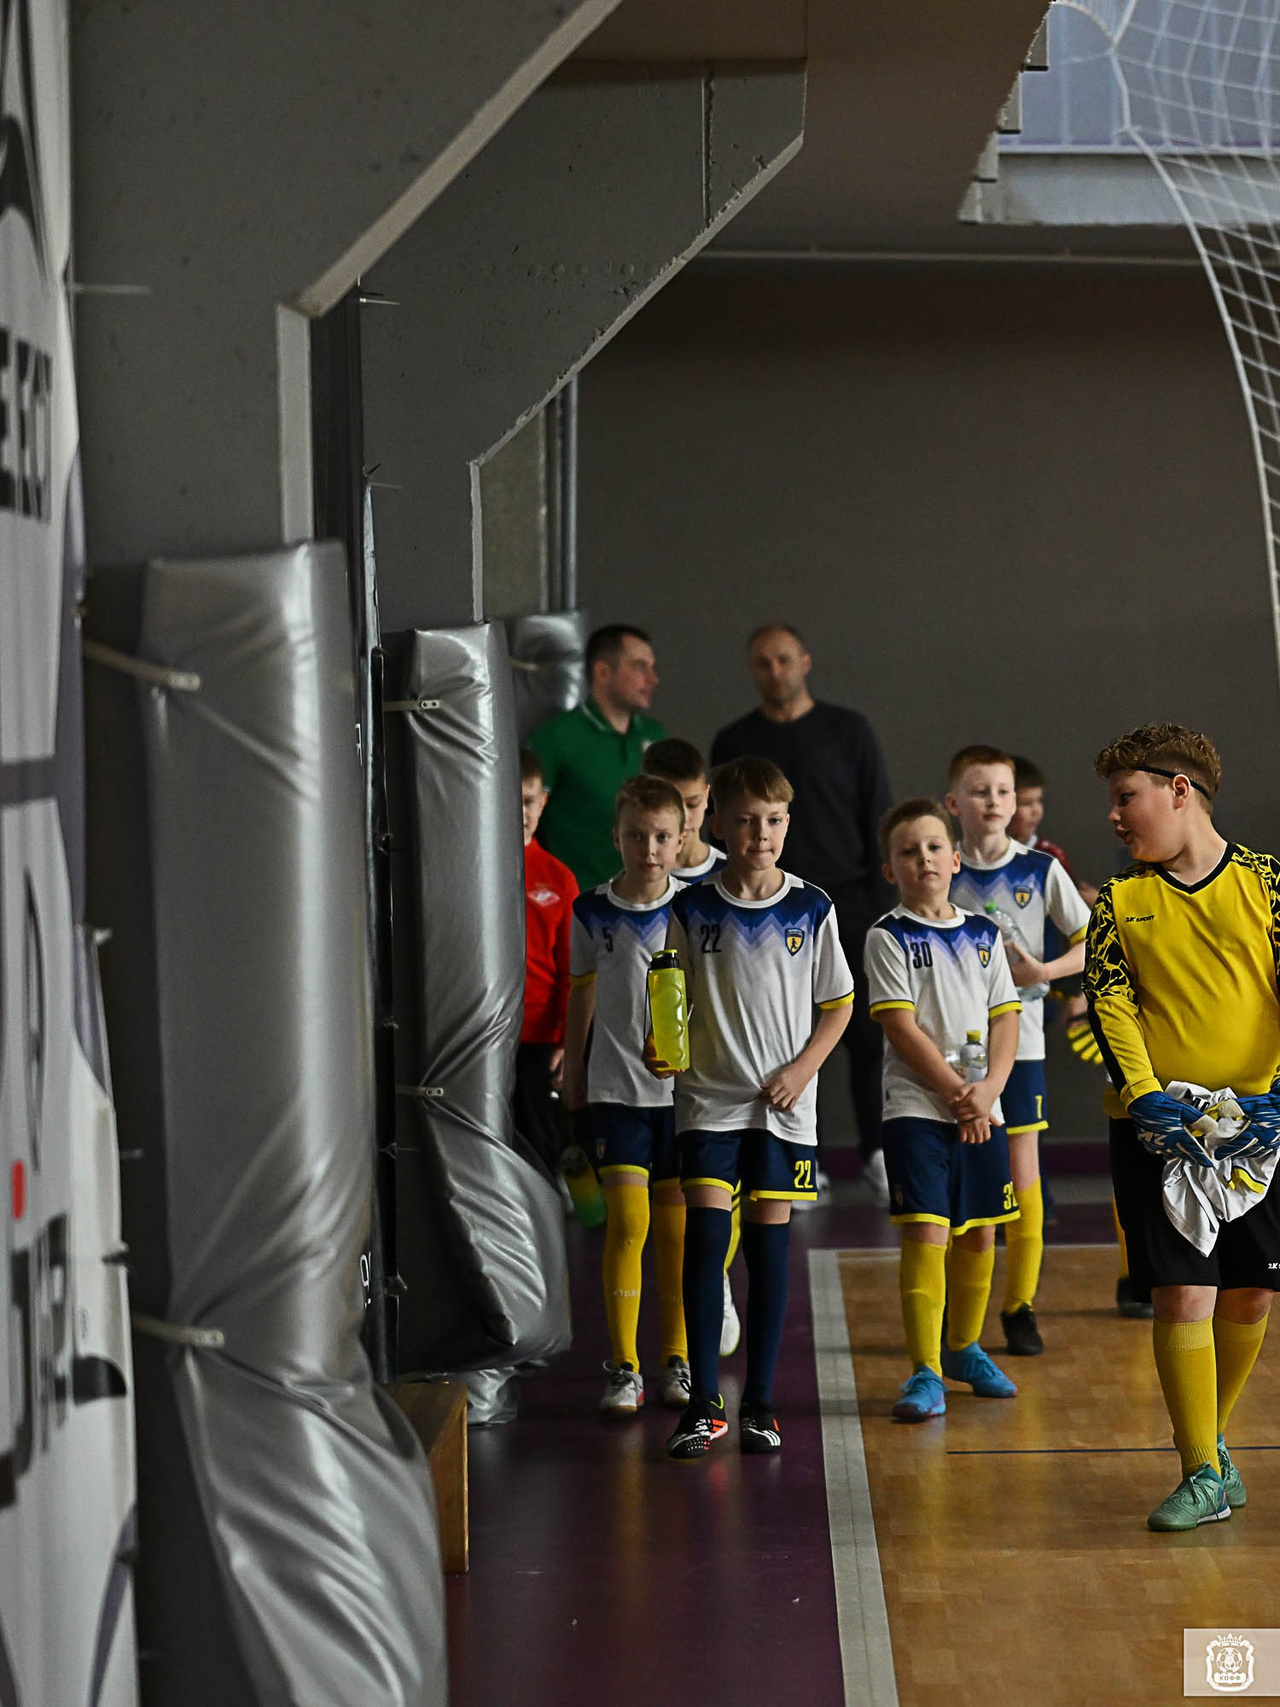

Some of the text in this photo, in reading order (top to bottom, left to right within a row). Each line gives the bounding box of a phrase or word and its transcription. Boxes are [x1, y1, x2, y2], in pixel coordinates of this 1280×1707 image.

[701, 924, 722, 953] 22
[910, 941, 933, 969] 30
[794, 1160, 814, 1189] 22
